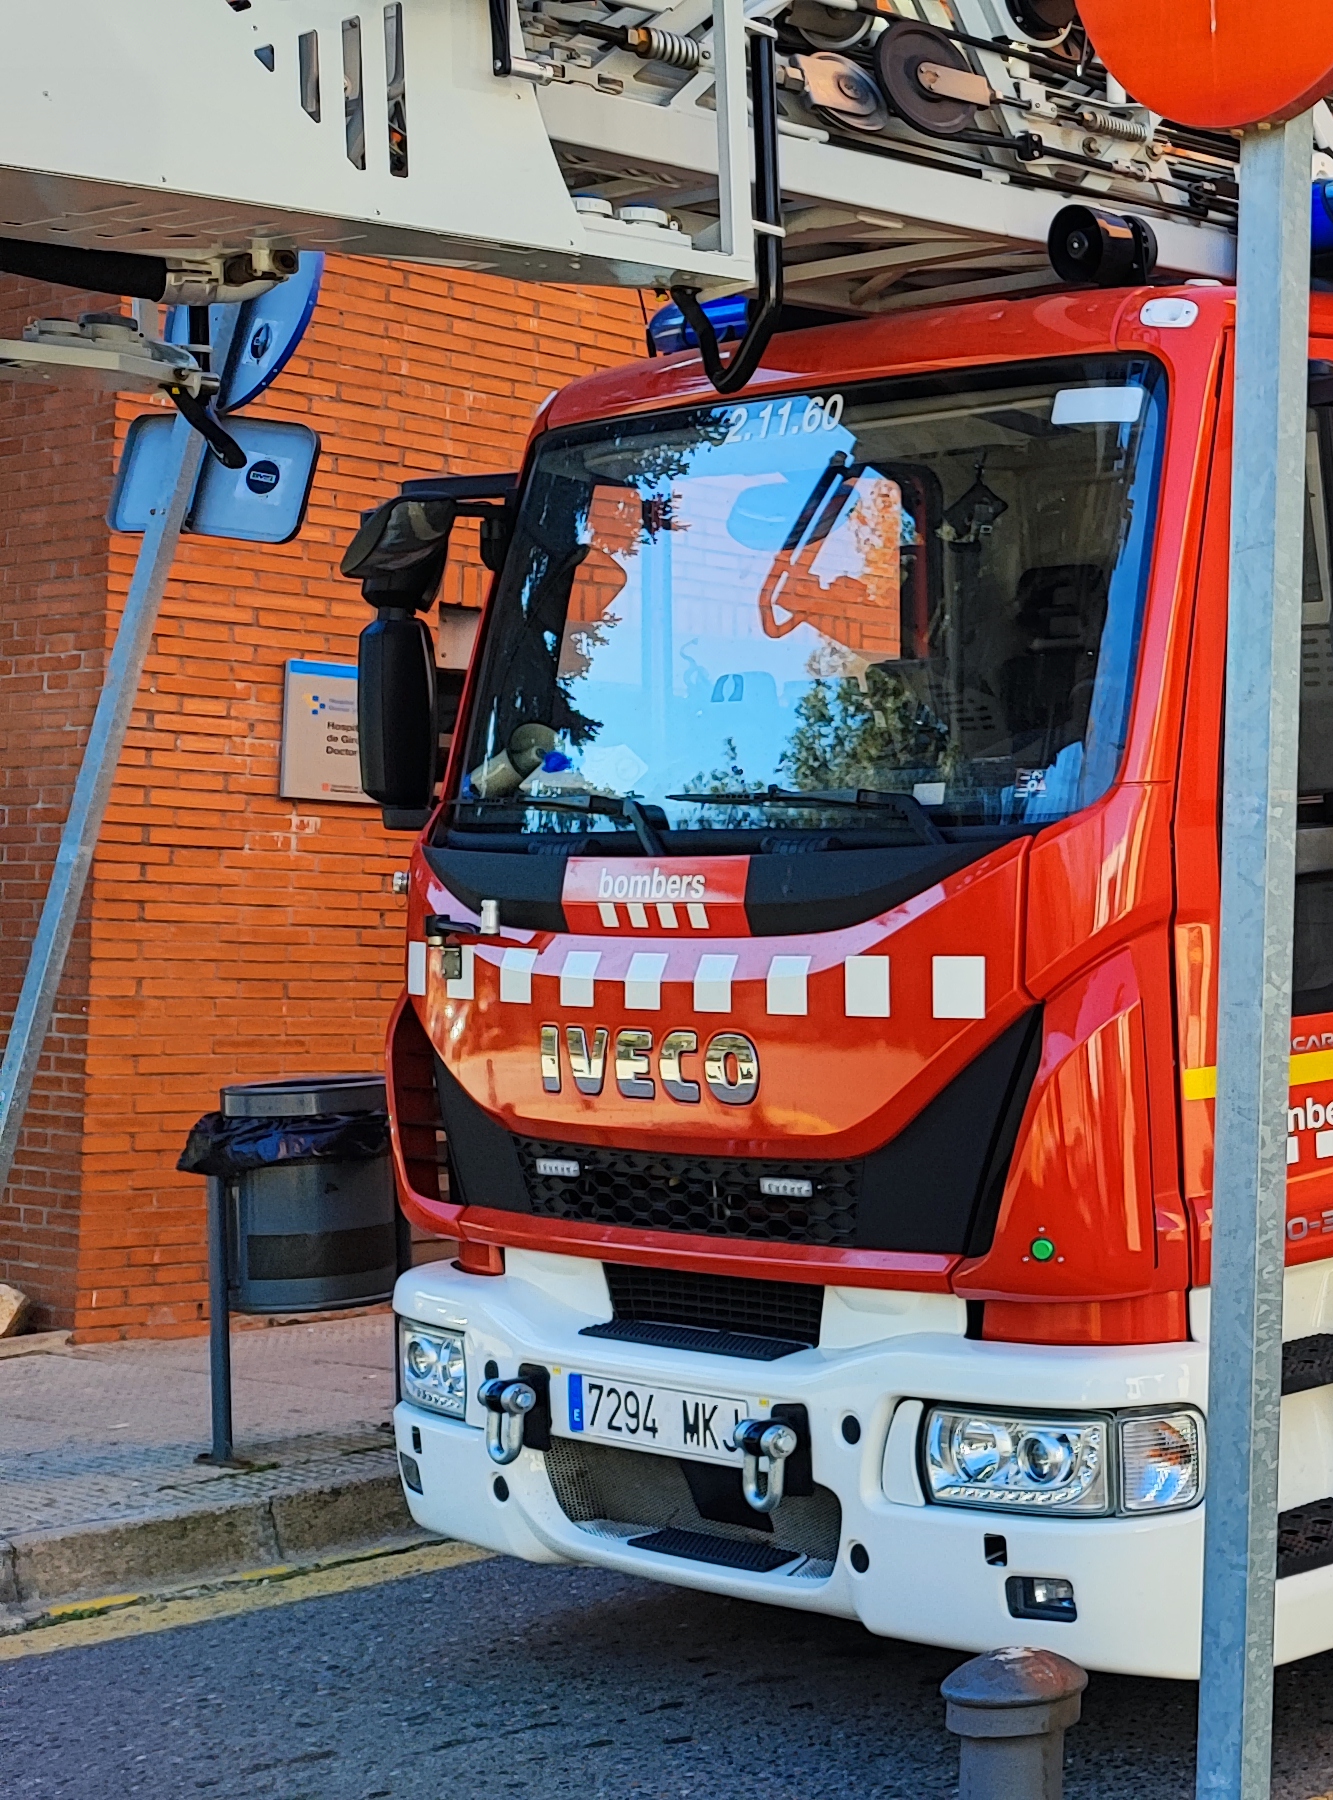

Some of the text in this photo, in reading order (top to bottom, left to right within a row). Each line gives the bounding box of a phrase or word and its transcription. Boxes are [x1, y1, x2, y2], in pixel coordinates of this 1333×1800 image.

[725, 394, 844, 444] 2.11.60
[326, 745, 357, 756] Doctor
[598, 867, 706, 899] bombers
[540, 1025, 760, 1106] IVECO
[573, 1408, 581, 1422] E
[588, 1382, 659, 1439] 7294
